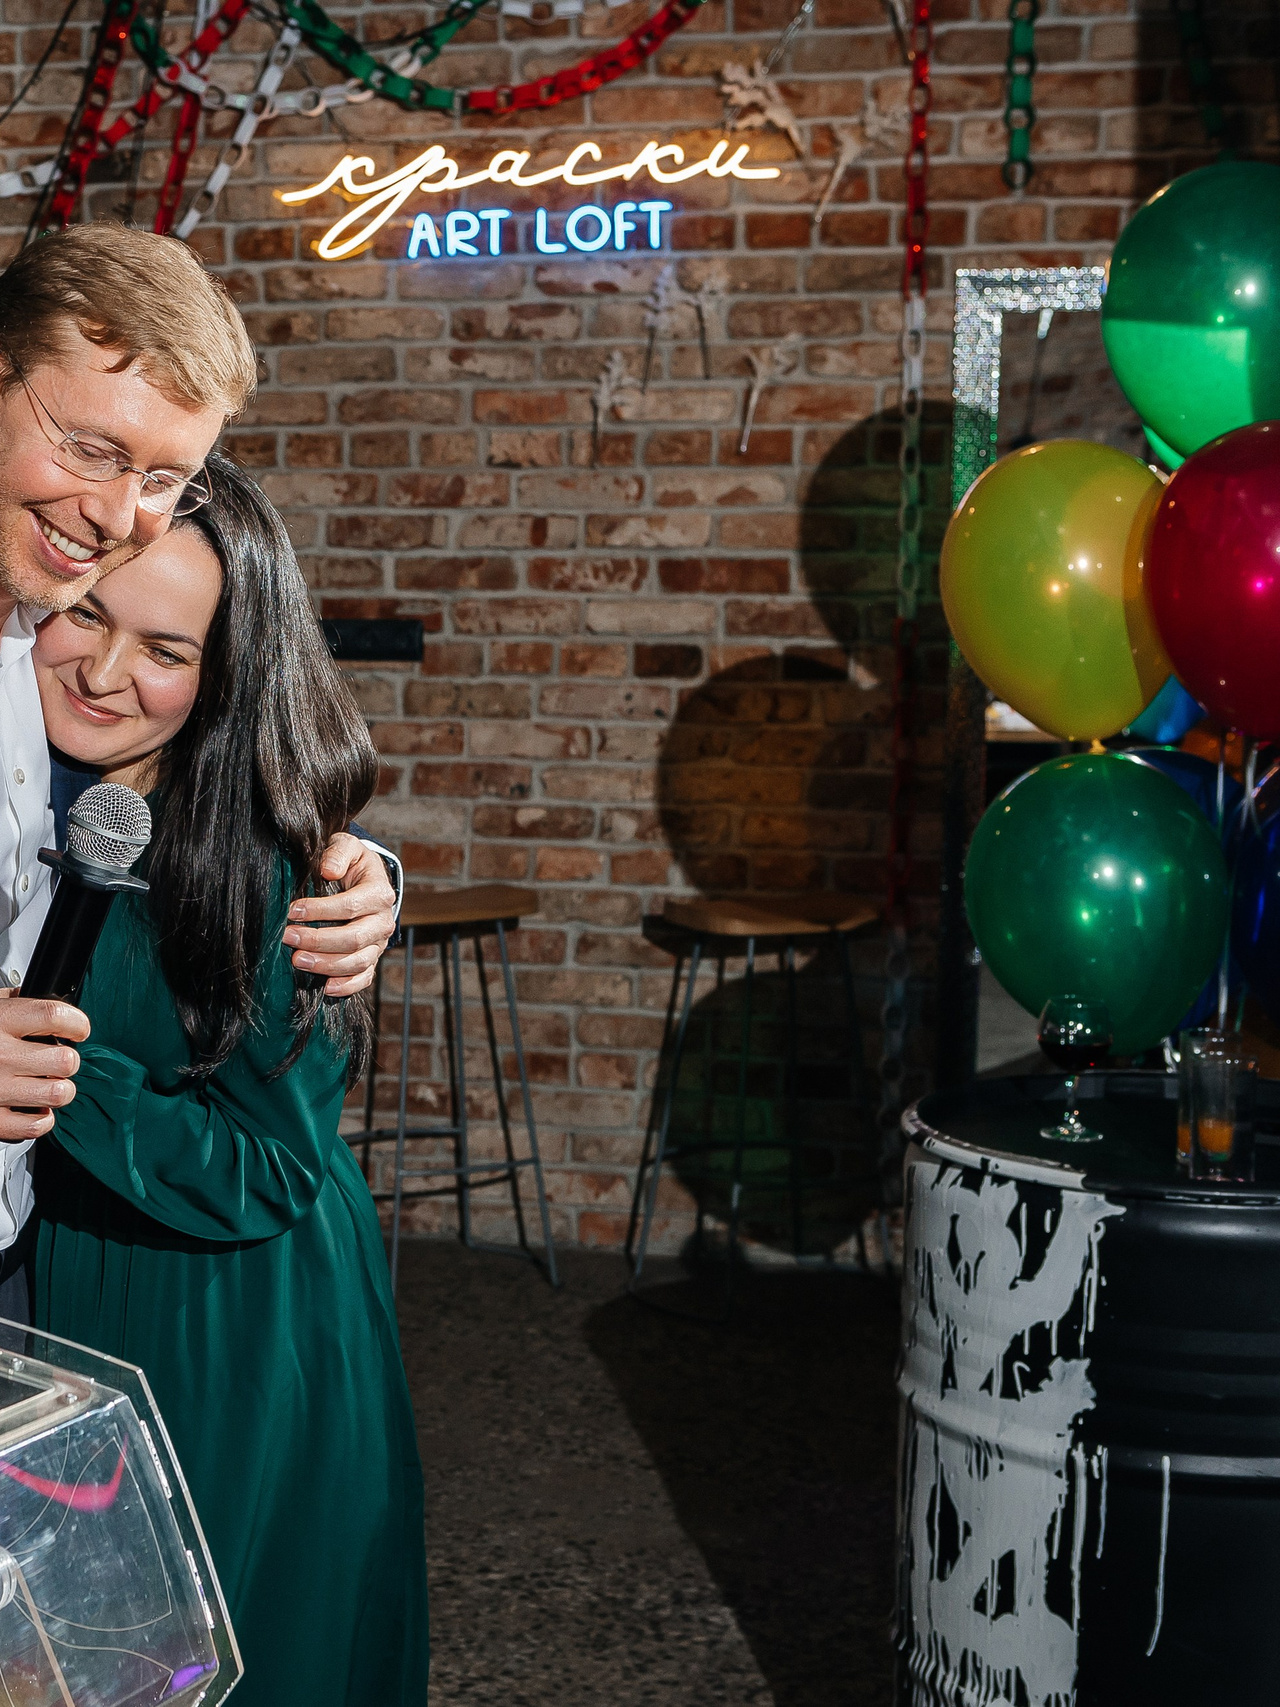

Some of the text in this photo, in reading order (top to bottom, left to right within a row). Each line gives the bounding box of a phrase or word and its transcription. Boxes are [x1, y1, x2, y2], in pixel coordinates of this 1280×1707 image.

[280, 139, 782, 260] краски
[407, 201, 674, 259] ART LOFT
